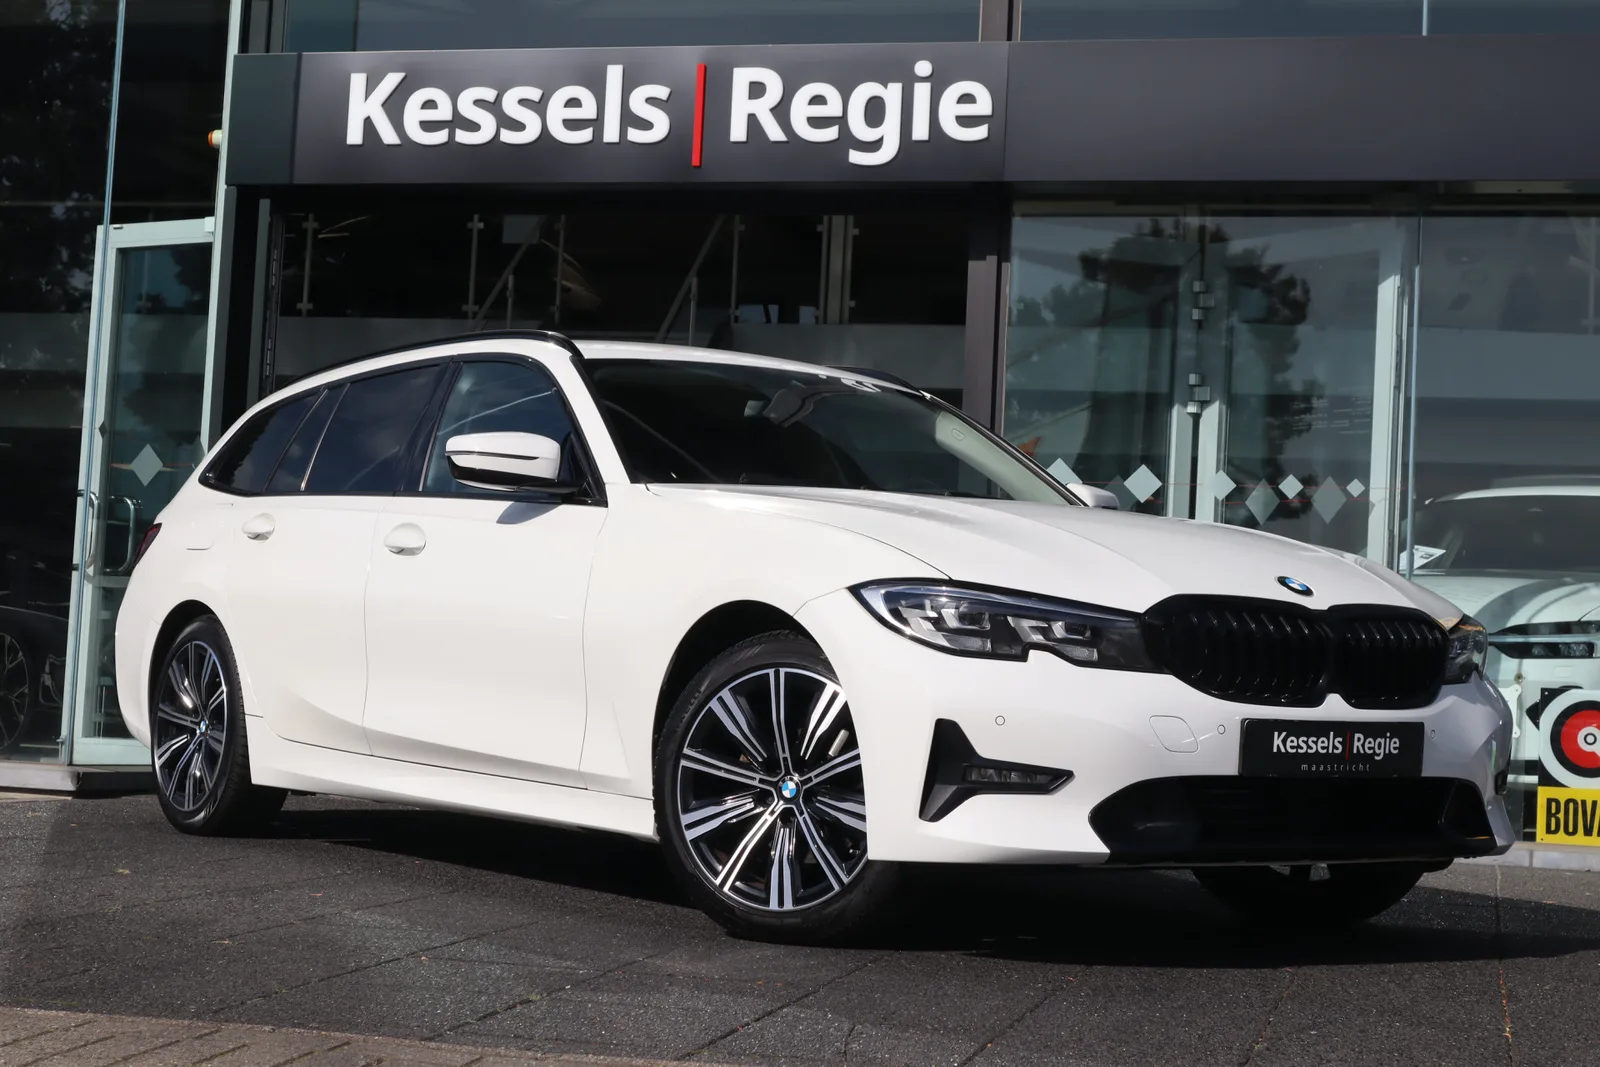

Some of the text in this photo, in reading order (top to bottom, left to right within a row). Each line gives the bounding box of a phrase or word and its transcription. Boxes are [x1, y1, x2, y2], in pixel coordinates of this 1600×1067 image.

[345, 59, 994, 166] Kessels Regie
[1272, 731, 1400, 761] Kessels Regie
[1300, 763, 1371, 772] maastricht
[1545, 797, 1600, 837] BOV
